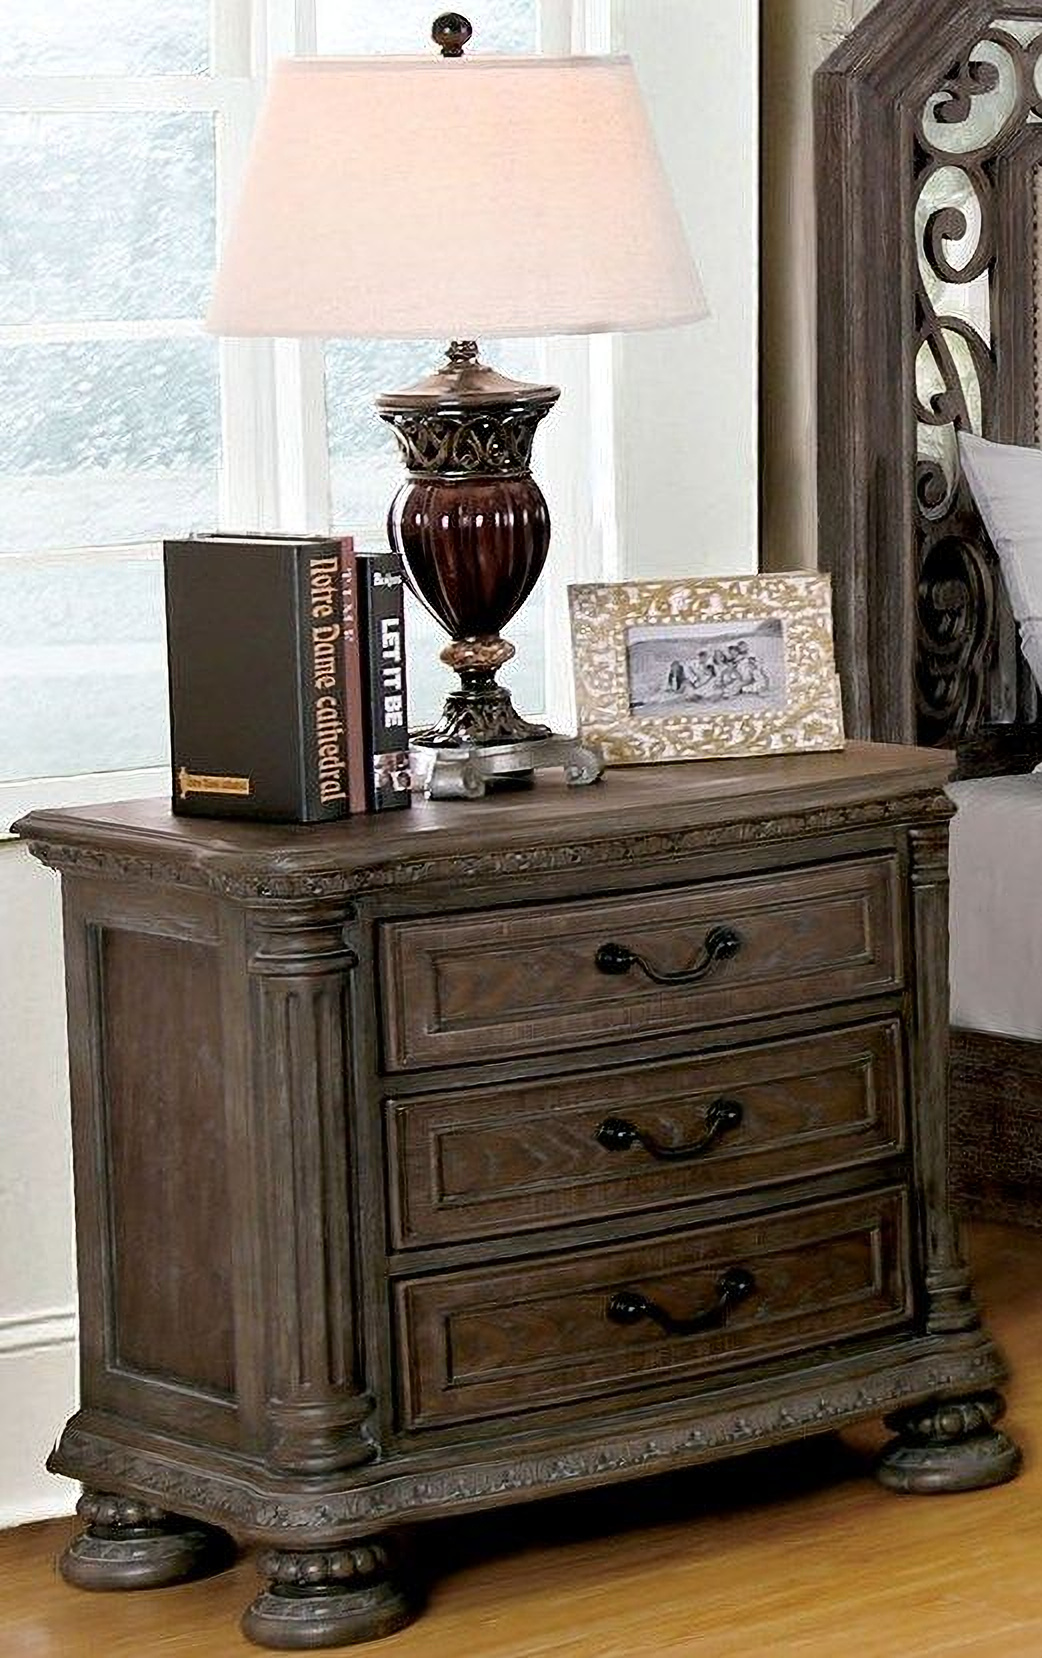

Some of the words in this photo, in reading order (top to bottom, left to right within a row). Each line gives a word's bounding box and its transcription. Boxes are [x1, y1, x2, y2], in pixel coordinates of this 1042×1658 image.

[309, 557, 339, 618] Notre
[312, 623, 340, 689] Dame
[381, 618, 402, 662] LET
[382, 667, 402, 690] IT
[384, 695, 403, 728] BE
[316, 696, 346, 805] cathedral
